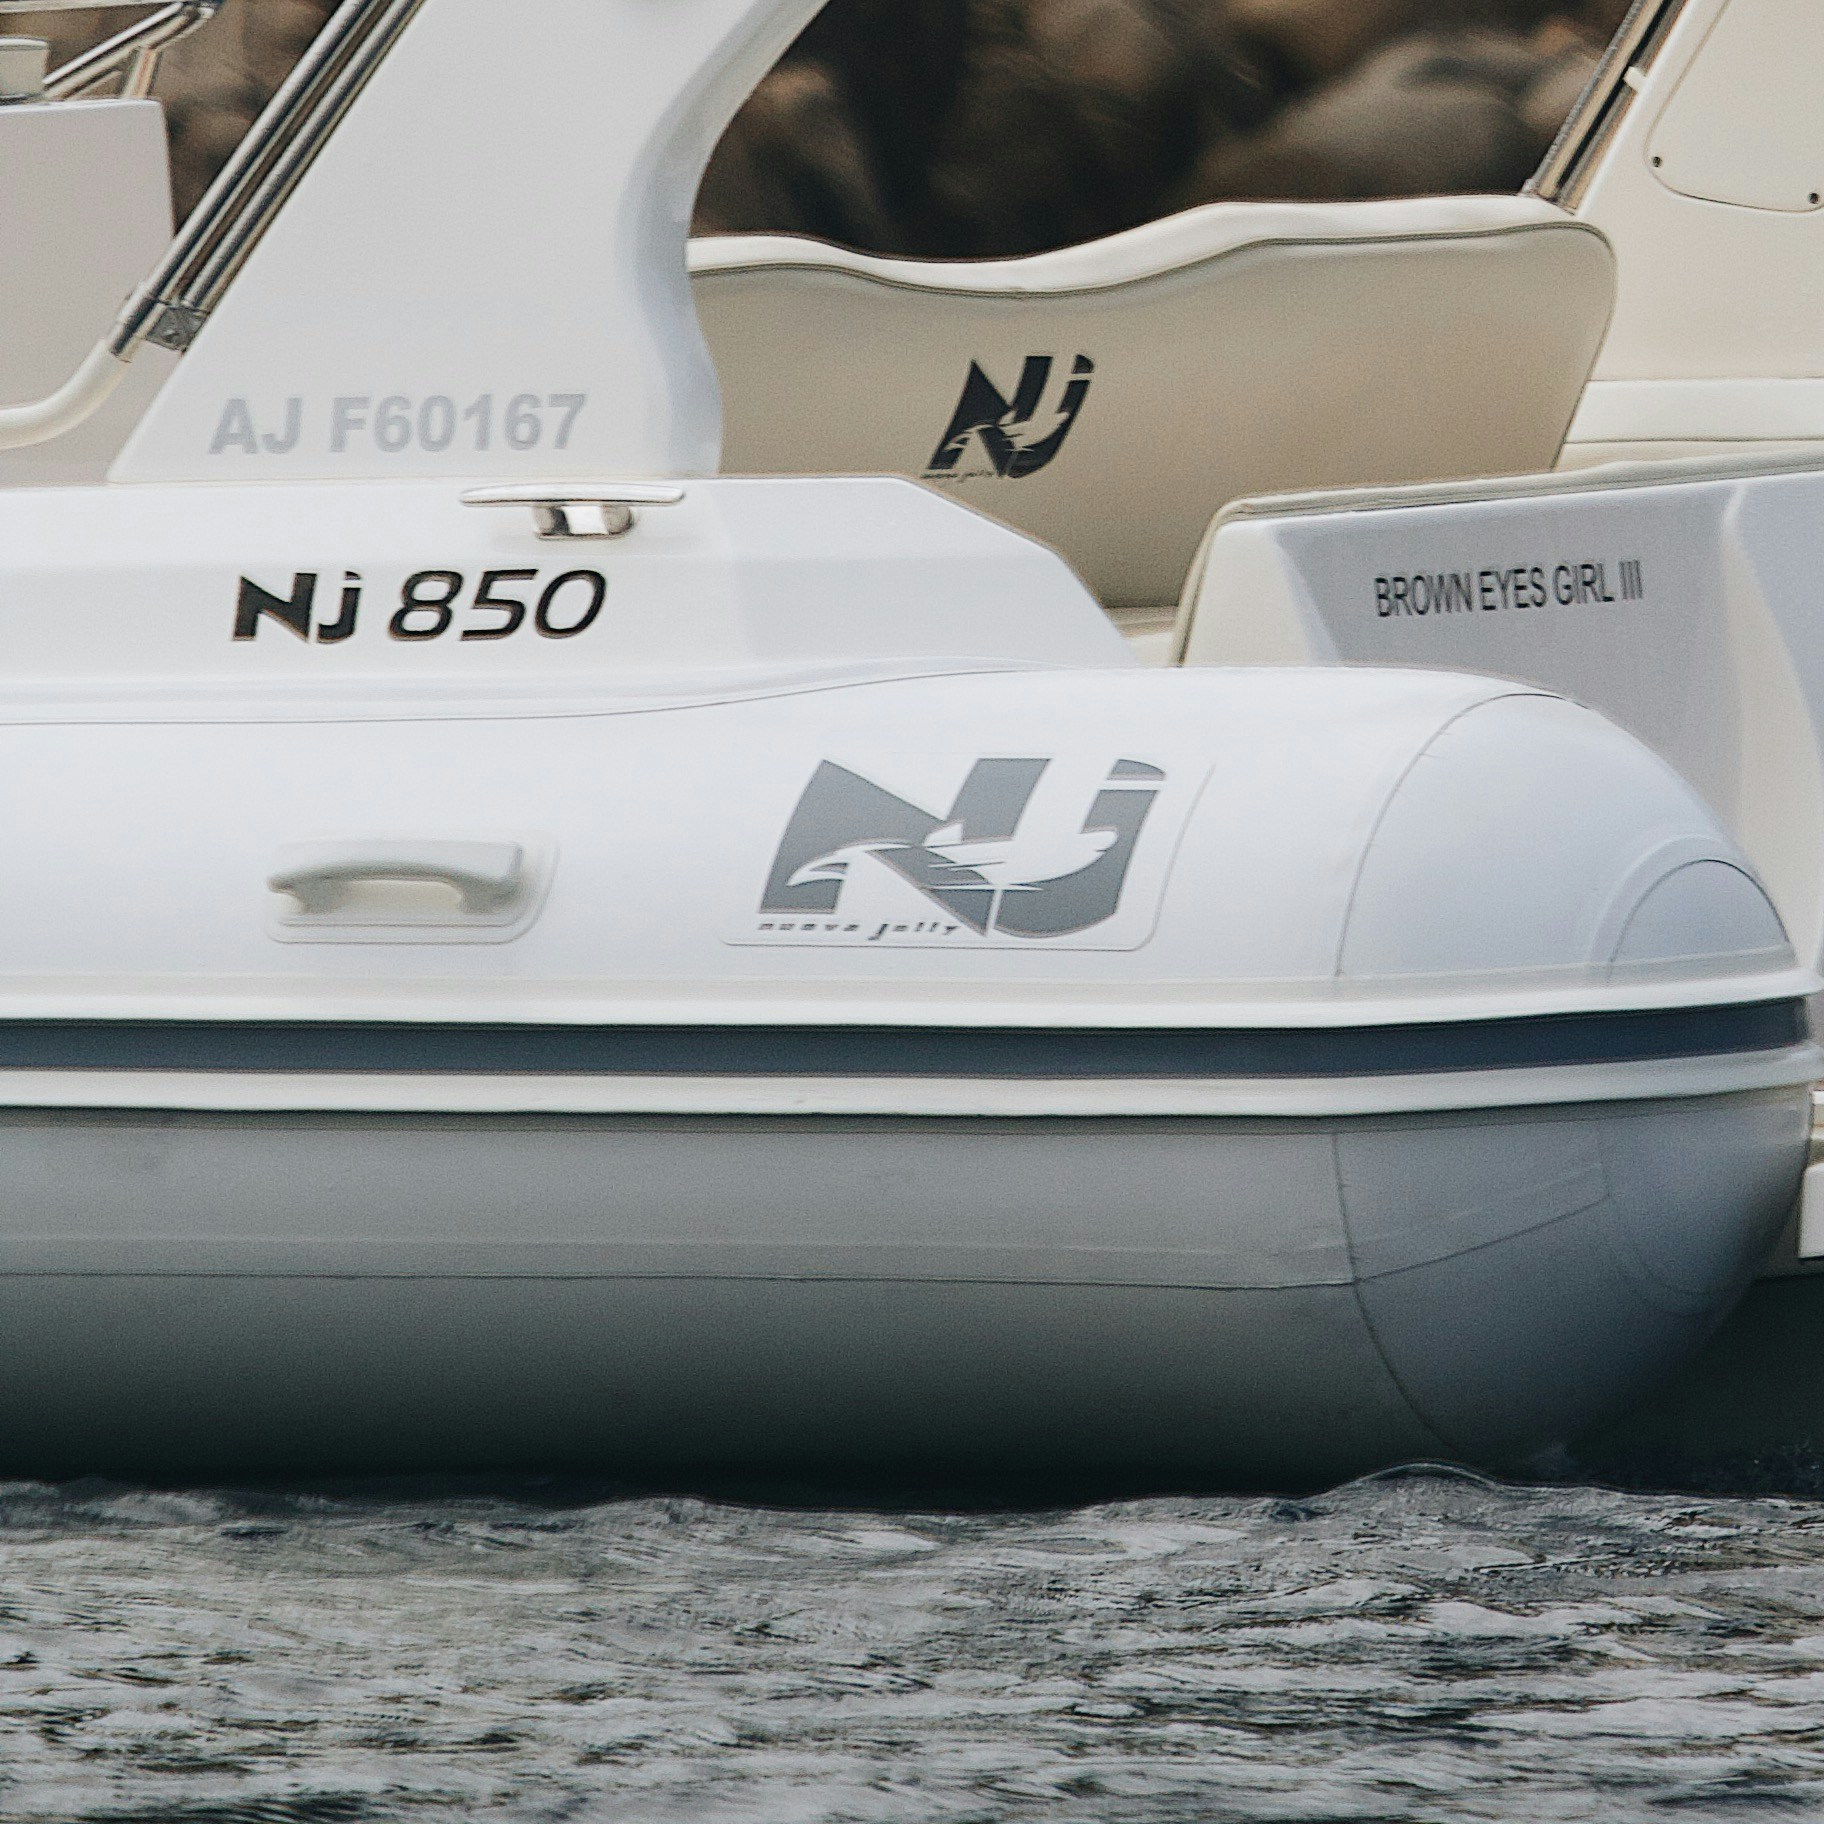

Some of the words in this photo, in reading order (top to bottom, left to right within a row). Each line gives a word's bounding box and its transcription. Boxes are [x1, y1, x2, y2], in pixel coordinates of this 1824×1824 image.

[209, 397, 303, 454] AJ
[329, 393, 587, 453] F60167
[388, 568, 607, 642] 850
[1374, 574, 1473, 617] BROWN
[1479, 567, 1547, 611] EYES
[1554, 563, 1615, 605] GIRL
